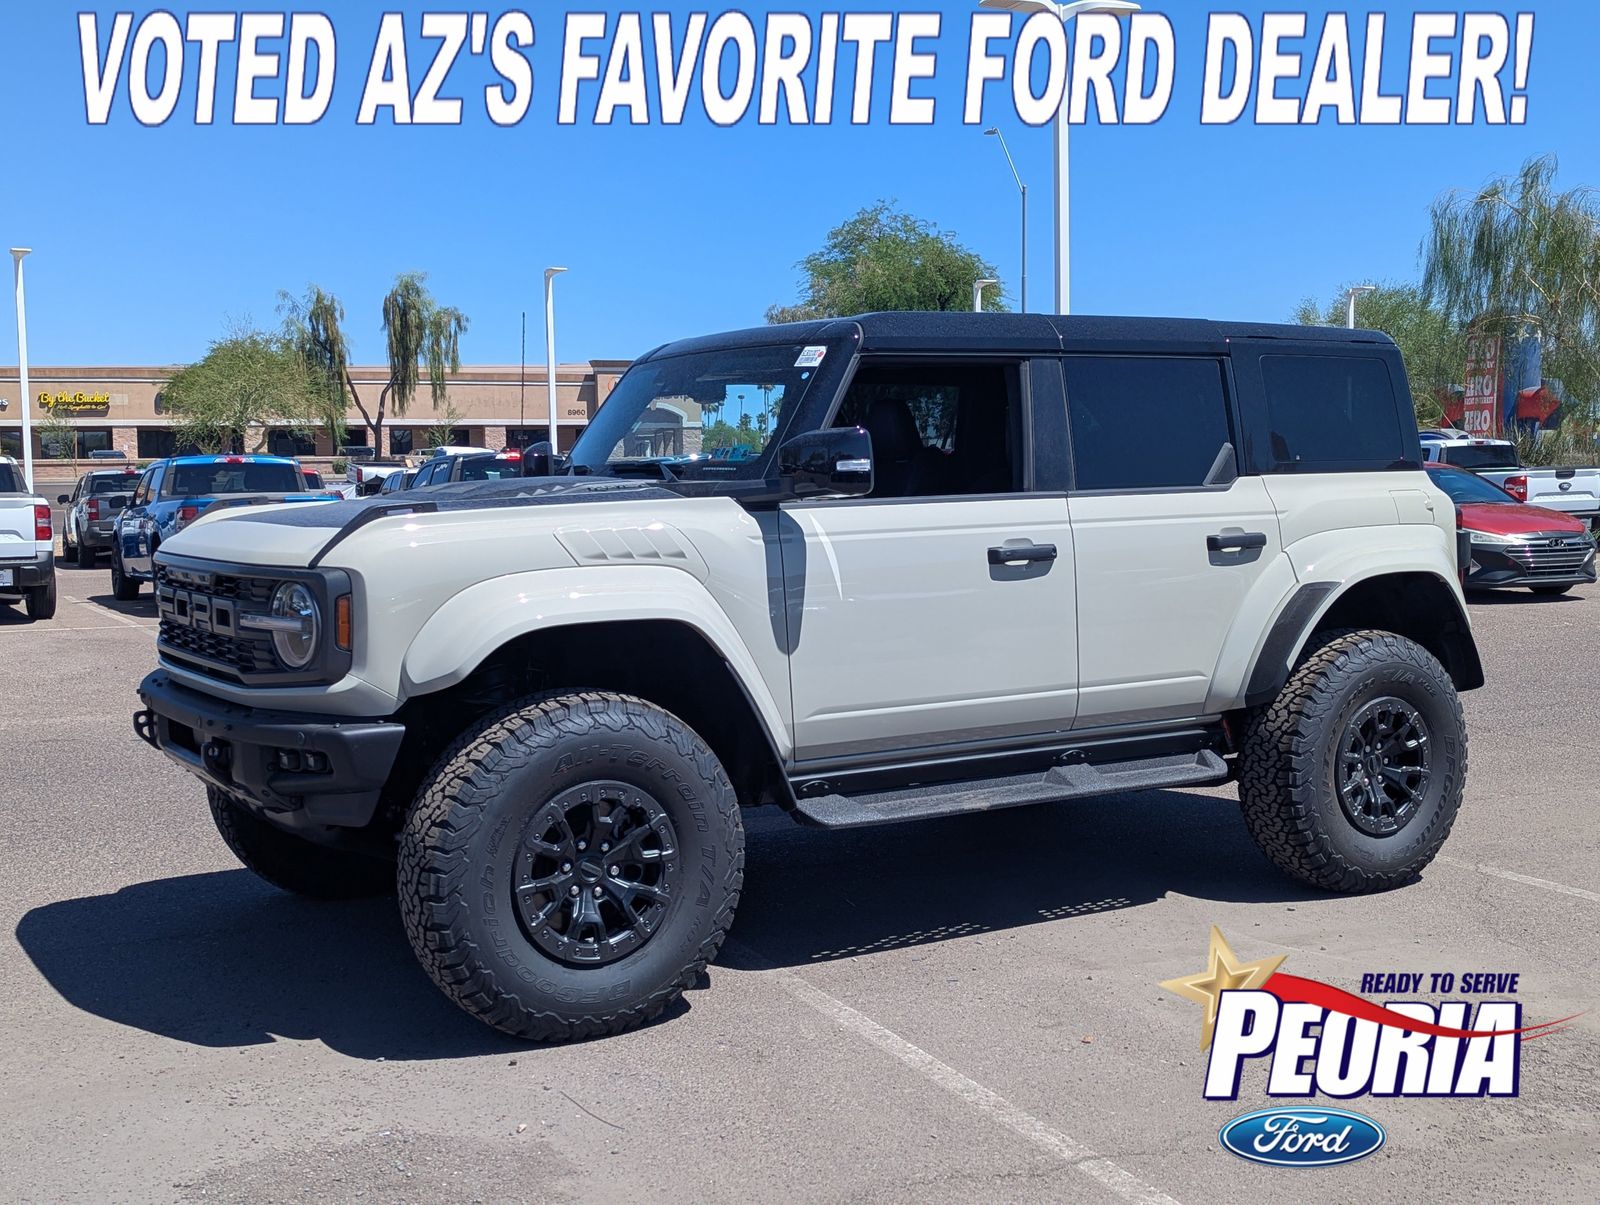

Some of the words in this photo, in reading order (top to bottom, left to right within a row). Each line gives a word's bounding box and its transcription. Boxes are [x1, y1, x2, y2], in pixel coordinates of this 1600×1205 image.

[39, 391, 54, 407] By
[75, 391, 110, 403] Bucket
[1464, 409, 1491, 432] ZERO
[156, 584, 236, 637] FORD
